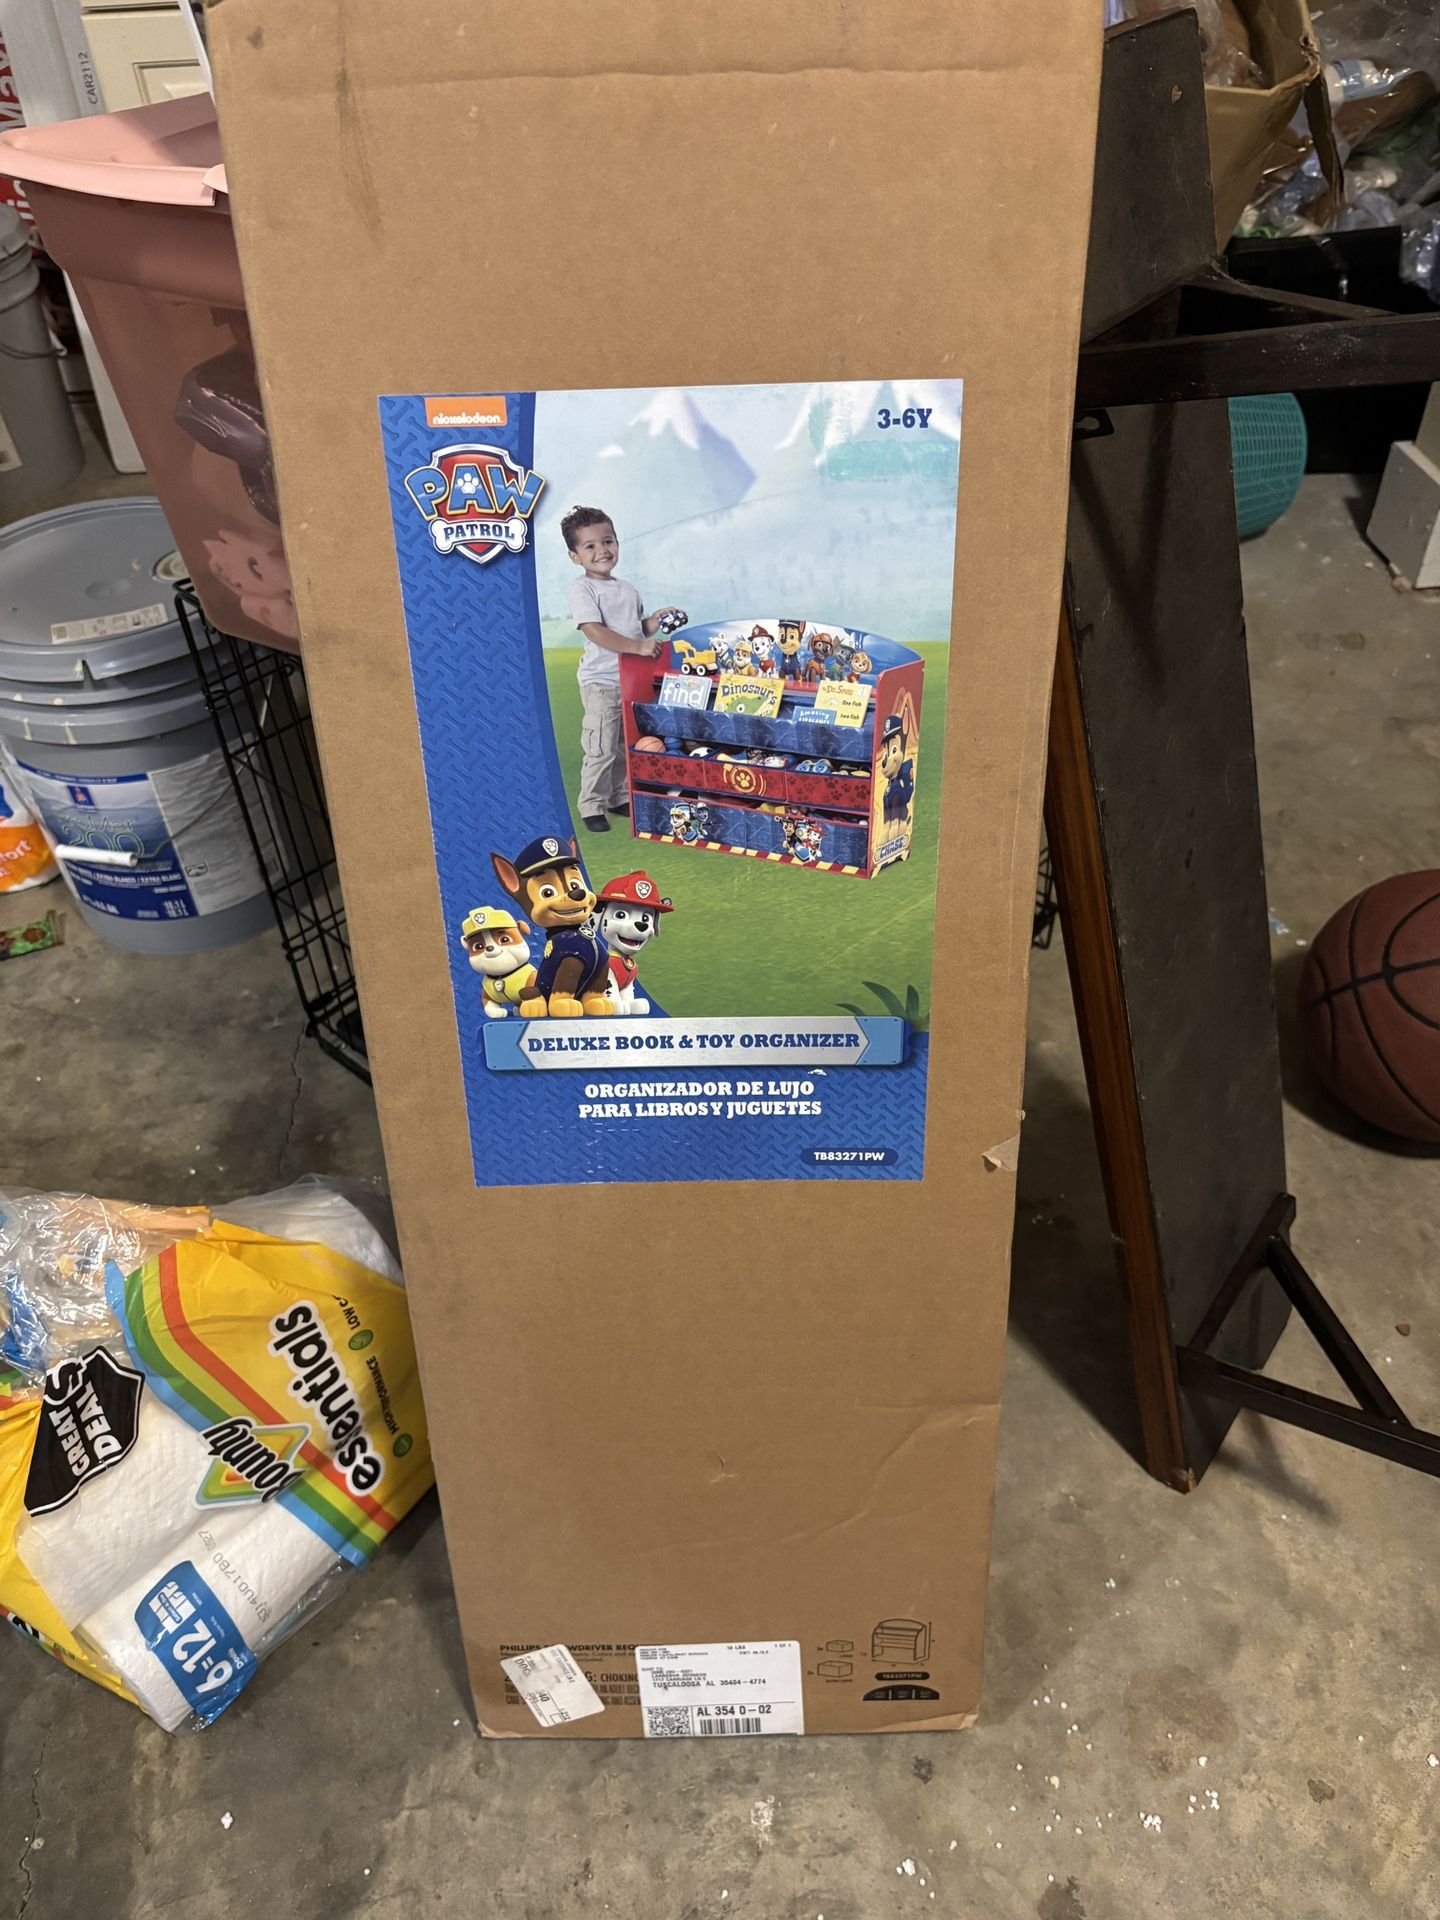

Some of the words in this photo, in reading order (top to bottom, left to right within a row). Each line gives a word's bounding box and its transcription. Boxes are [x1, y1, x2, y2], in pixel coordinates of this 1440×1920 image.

[78, 52, 98, 105] CAR2112
[432, 413, 501, 425] nickelodeon
[877, 409, 933, 430] 3-6Y
[404, 463, 546, 521] PAW
[443, 523, 516, 540] PATROL
[664, 683, 704, 705] find
[721, 683, 778, 705] Dinosaurs
[528, 1037, 610, 1052] DELUXE
[615, 1035, 675, 1050] BOOK
[679, 1035, 693, 1049] &
[696, 1034, 735, 1048] TOY
[739, 1033, 860, 1048] ORGANIZER
[584, 1081, 733, 1098] ORGANIZADOR
[736, 1081, 763, 1096] DE
[767, 1081, 814, 1099] LUJO
[578, 1103, 632, 1118] PARA
[635, 1102, 708, 1117] LIBROS
[707, 1101, 722, 1116] Y
[726, 1101, 822, 1119] JUGUETES
[813, 1151, 885, 1162] TB83271PW
[49, 1406, 91, 1477] GREAT
[202, 1418, 307, 1503] Bounty
[652, 1680, 701, 1688] TUSCALOOSA
[697, 1707, 711, 1717] AL
[715, 1706, 735, 1716] 354
